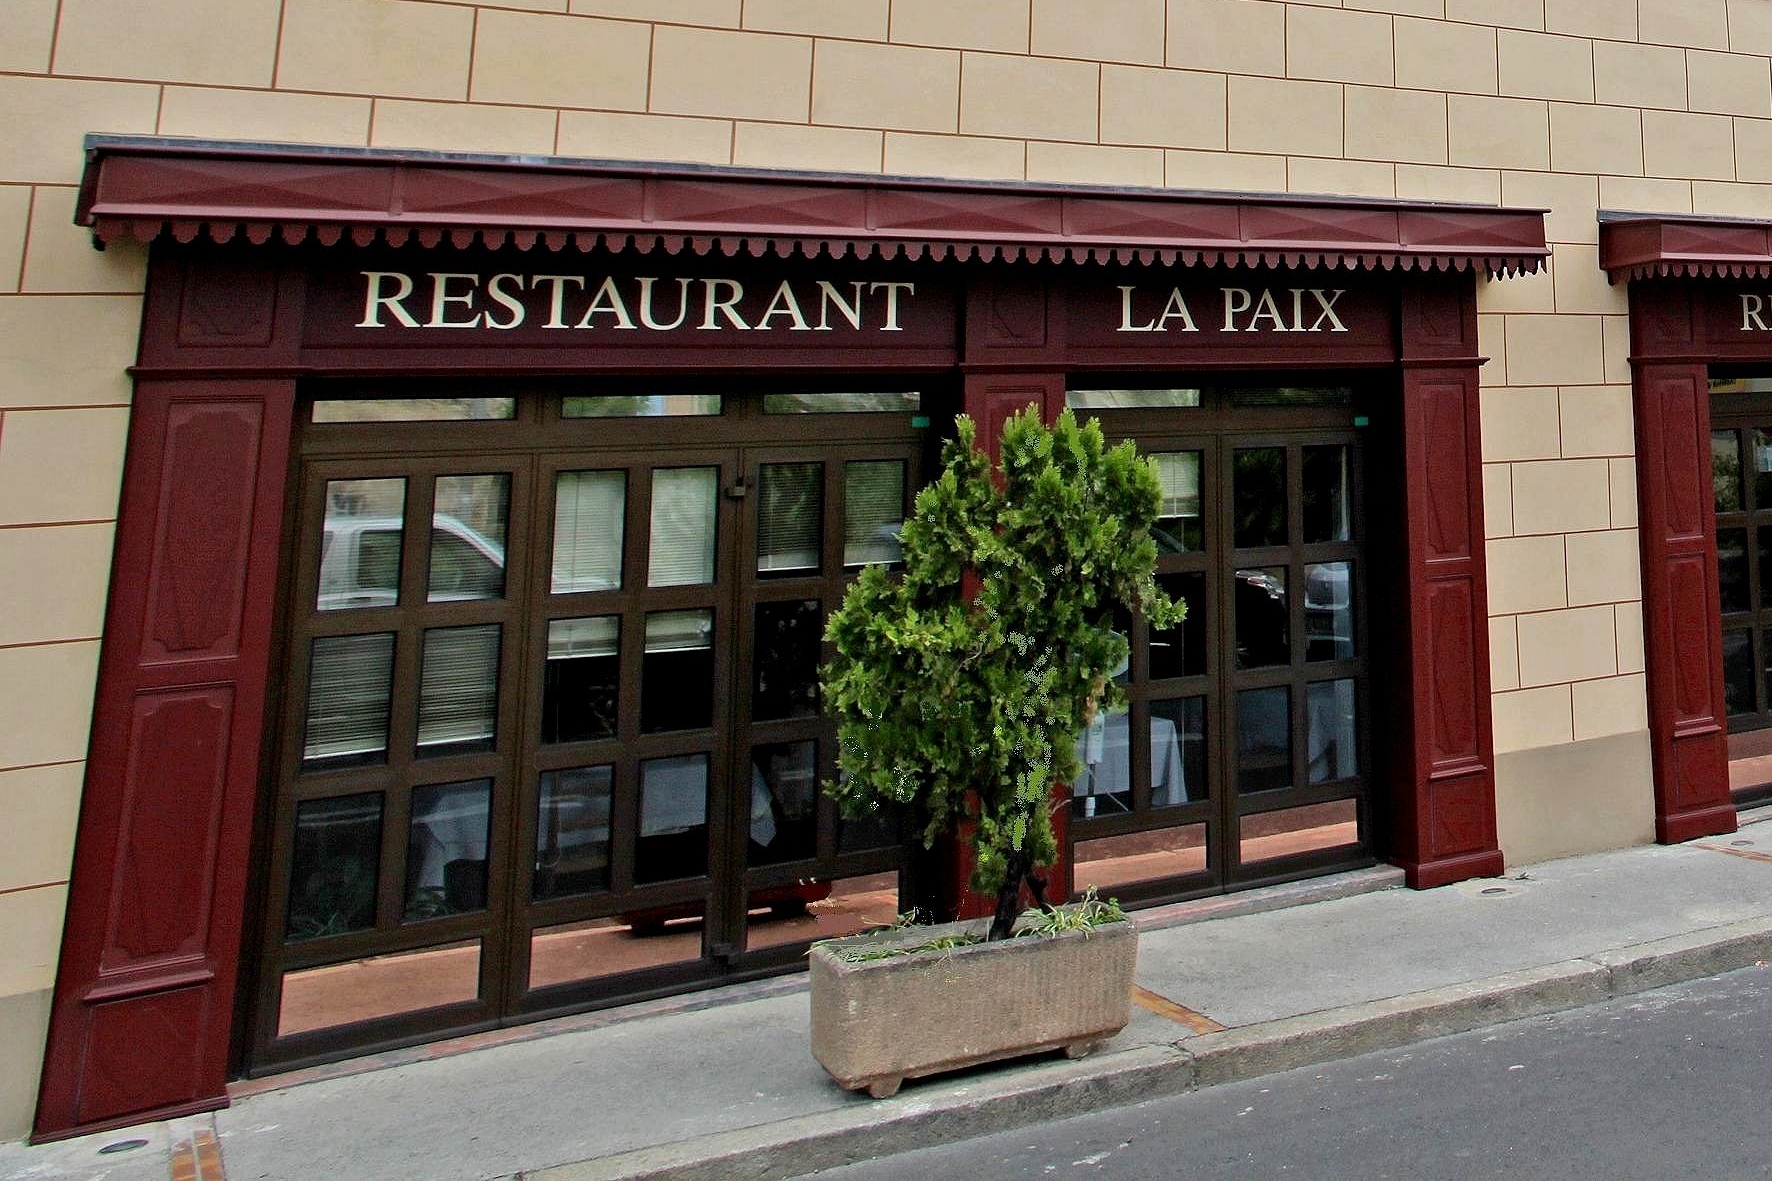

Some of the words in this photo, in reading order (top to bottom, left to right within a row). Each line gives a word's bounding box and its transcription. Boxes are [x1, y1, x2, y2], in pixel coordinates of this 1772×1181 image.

[355, 271, 915, 331] RESTAURANT
[1116, 285, 1200, 332] LA
[1219, 287, 1349, 332] PAIX
